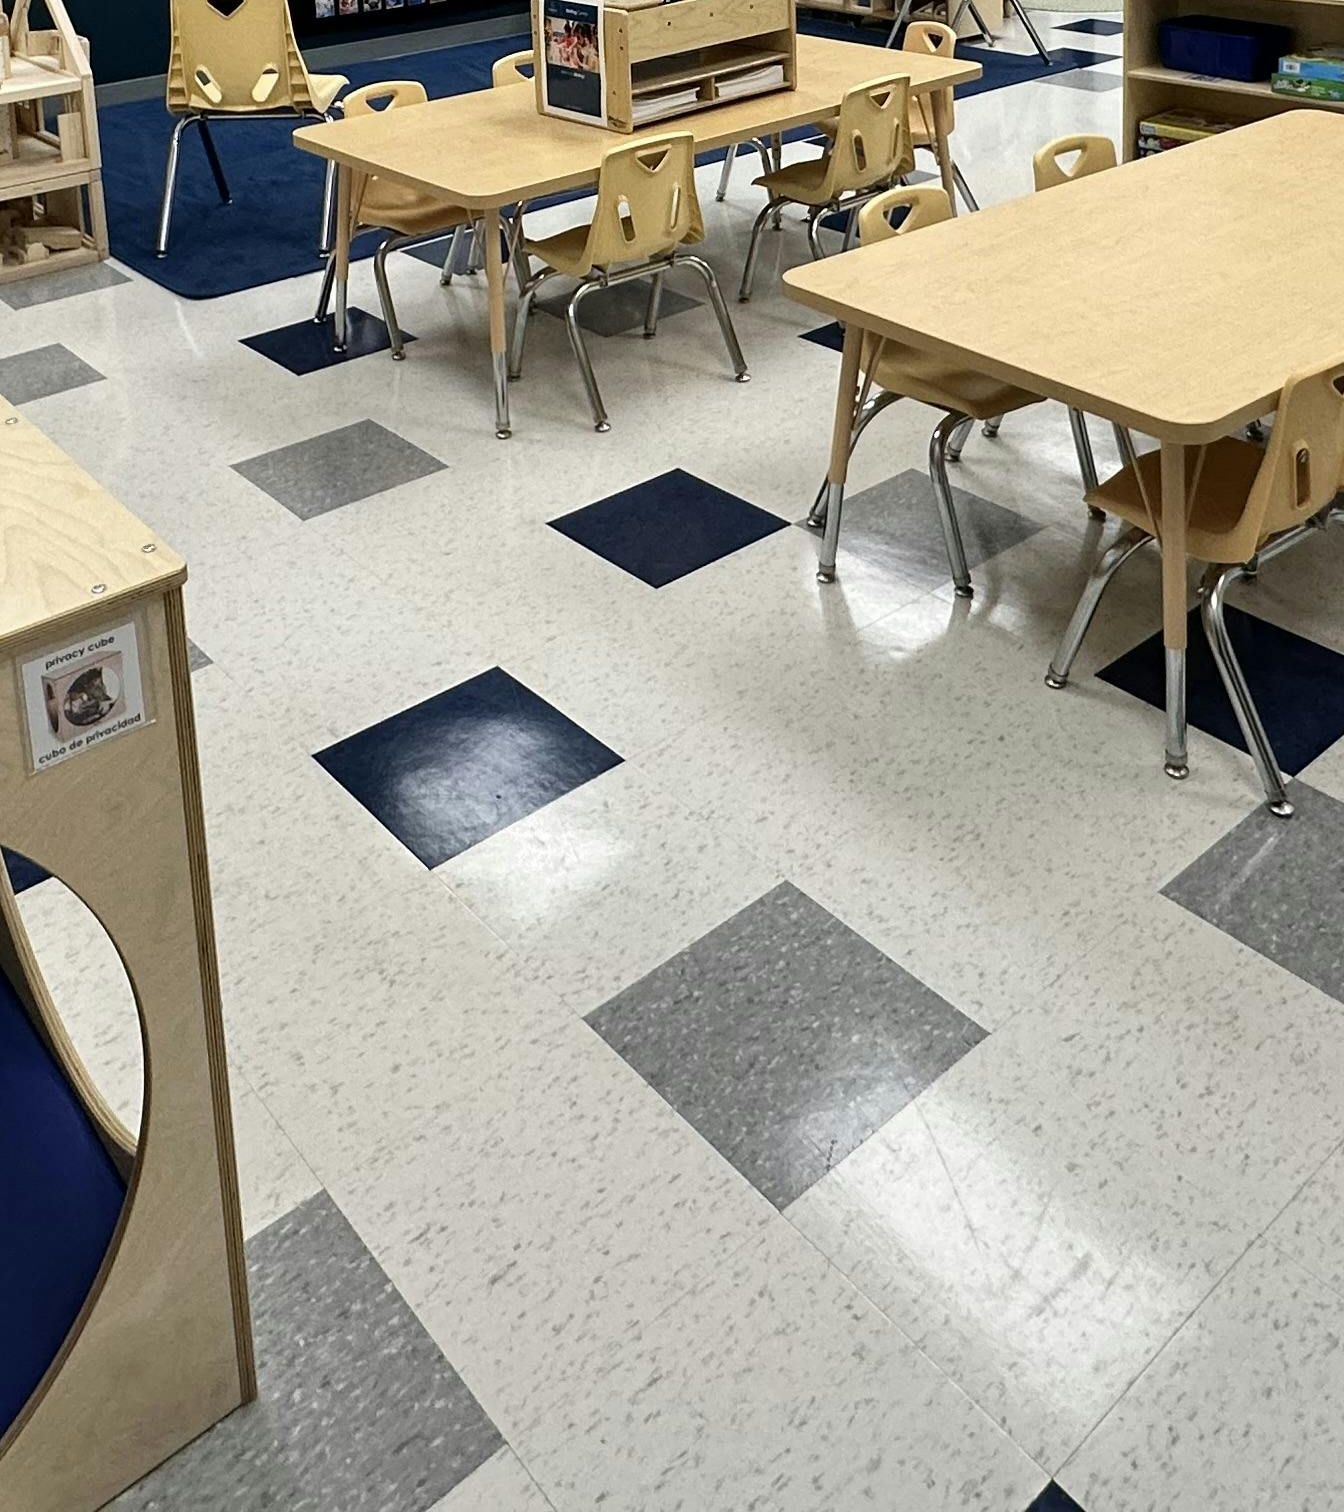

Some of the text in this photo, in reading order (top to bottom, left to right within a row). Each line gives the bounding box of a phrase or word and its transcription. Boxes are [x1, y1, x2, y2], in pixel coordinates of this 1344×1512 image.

[45, 636, 115, 670] privacy cube
[39, 713, 141, 764] cubo de privacidad
